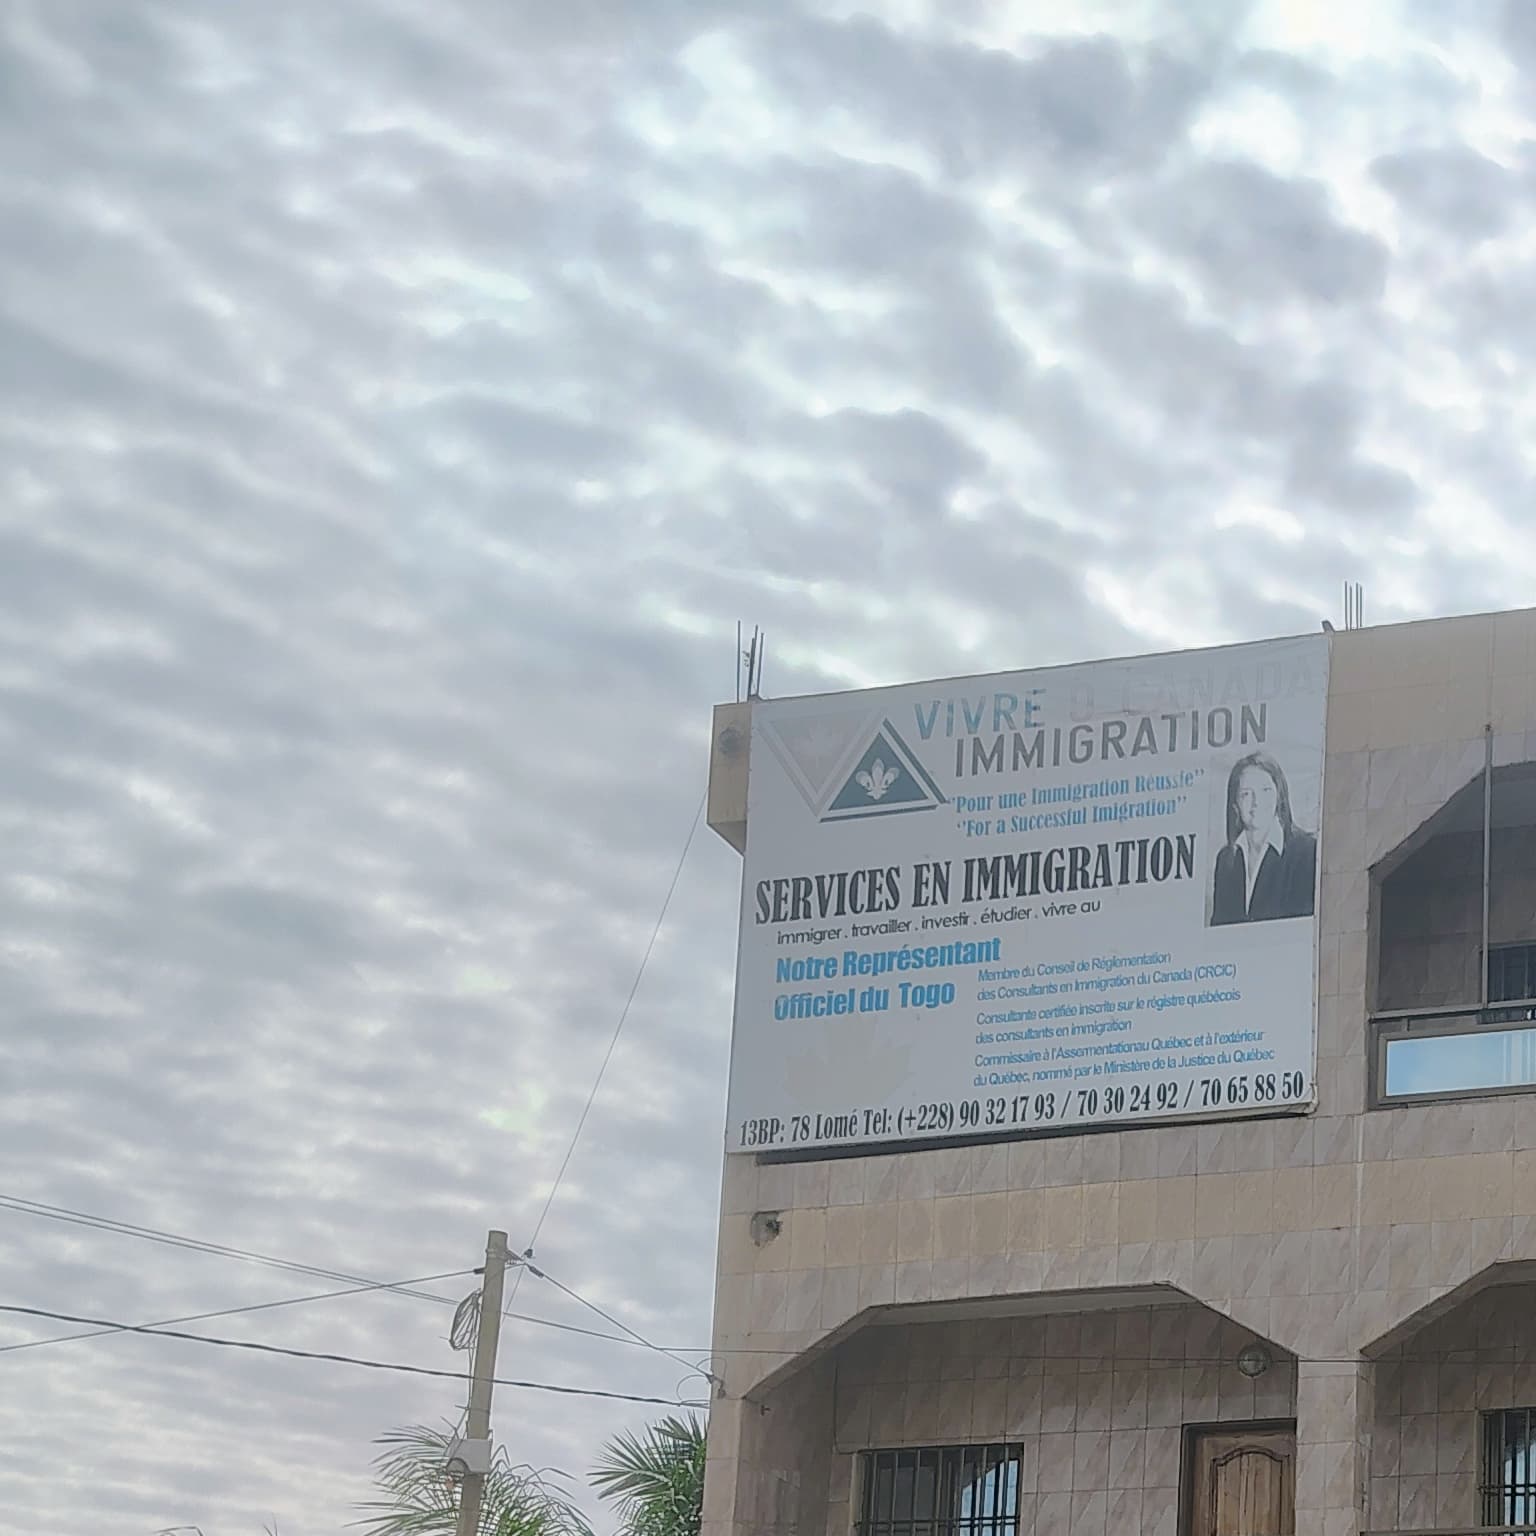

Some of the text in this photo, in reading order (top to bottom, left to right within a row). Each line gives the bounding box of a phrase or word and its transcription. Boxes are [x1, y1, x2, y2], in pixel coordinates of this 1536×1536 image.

[914, 688, 1047, 741] VIVRE
[955, 703, 1268, 778] IMMIGRATION
[998, 791, 1027, 809] une
[1032, 778, 1129, 806] Immigration
[996, 822, 1006, 835] a
[1011, 807, 1087, 833] Successful
[755, 833, 1198, 925] SERVICES EN IMMIGRATION
[777, 927, 842, 945] immigrer
[852, 919, 912, 937] travailler
[921, 911, 970, 929] investir
[981, 907, 1032, 924] étudier
[1041, 902, 1077, 917] vivre
[1080, 899, 1102, 914] au
[776, 937, 1001, 983] Notre Représentant
[978, 967, 1021, 982] Membre
[1022, 965, 1035, 978] du
[1037, 961, 1075, 976] Conseil
[1076, 959, 1090, 972] de
[774, 980, 956, 1021] Officiel du Togo
[977, 988, 996, 1001] des
[998, 983, 1058, 999] Consultants
[1059, 982, 1073, 993] en
[1075, 974, 1136, 992] Immigration
[1137, 972, 1151, 984] du
[1153, 968, 1193, 984] Canada
[977, 1010, 1036, 1025] Consultante
[1079, 1000, 1115, 1015] inscrite
[1117, 1001, 1133, 1012] sur
[1136, 997, 1145, 1009] le
[975, 1018, 1132, 1044] des consultants en immigration
[974, 1074, 988, 1087] du
[1074, 1066, 1093, 1080] par
[1093, 1063, 1102, 1075] le
[1152, 1057, 1166, 1070] de
[1167, 1056, 1177, 1069] la
[1178, 1053, 1215, 1068] Justice
[1217, 1050, 1231, 1063] du
[975, 1050, 1041, 1067] Commissaire
[1151, 1036, 1193, 1052] Québec
[1193, 1034, 1204, 1047] et
[740, 1117, 785, 1146] 13BP:
[791, 1115, 810, 1142] 78
[815, 1108, 858, 1140] Lomé
[863, 1108, 892, 1136] Tel:
[897, 1101, 954, 1136] (+228)
[959, 1099, 981, 1128] 90
[985, 1097, 1006, 1125] 32
[1011, 1095, 1030, 1122] 17
[1034, 1092, 1055, 1120] 93
[1077, 1089, 1098, 1117] 70
[1103, 1086, 1125, 1114] 30
[1129, 1084, 1151, 1112] 24
[1157, 1082, 1178, 1110] 92
[1200, 1078, 1222, 1106] 70
[1227, 1075, 1248, 1104] 65
[1254, 1073, 1276, 1101] 88
[1282, 1070, 1304, 1099] 50
